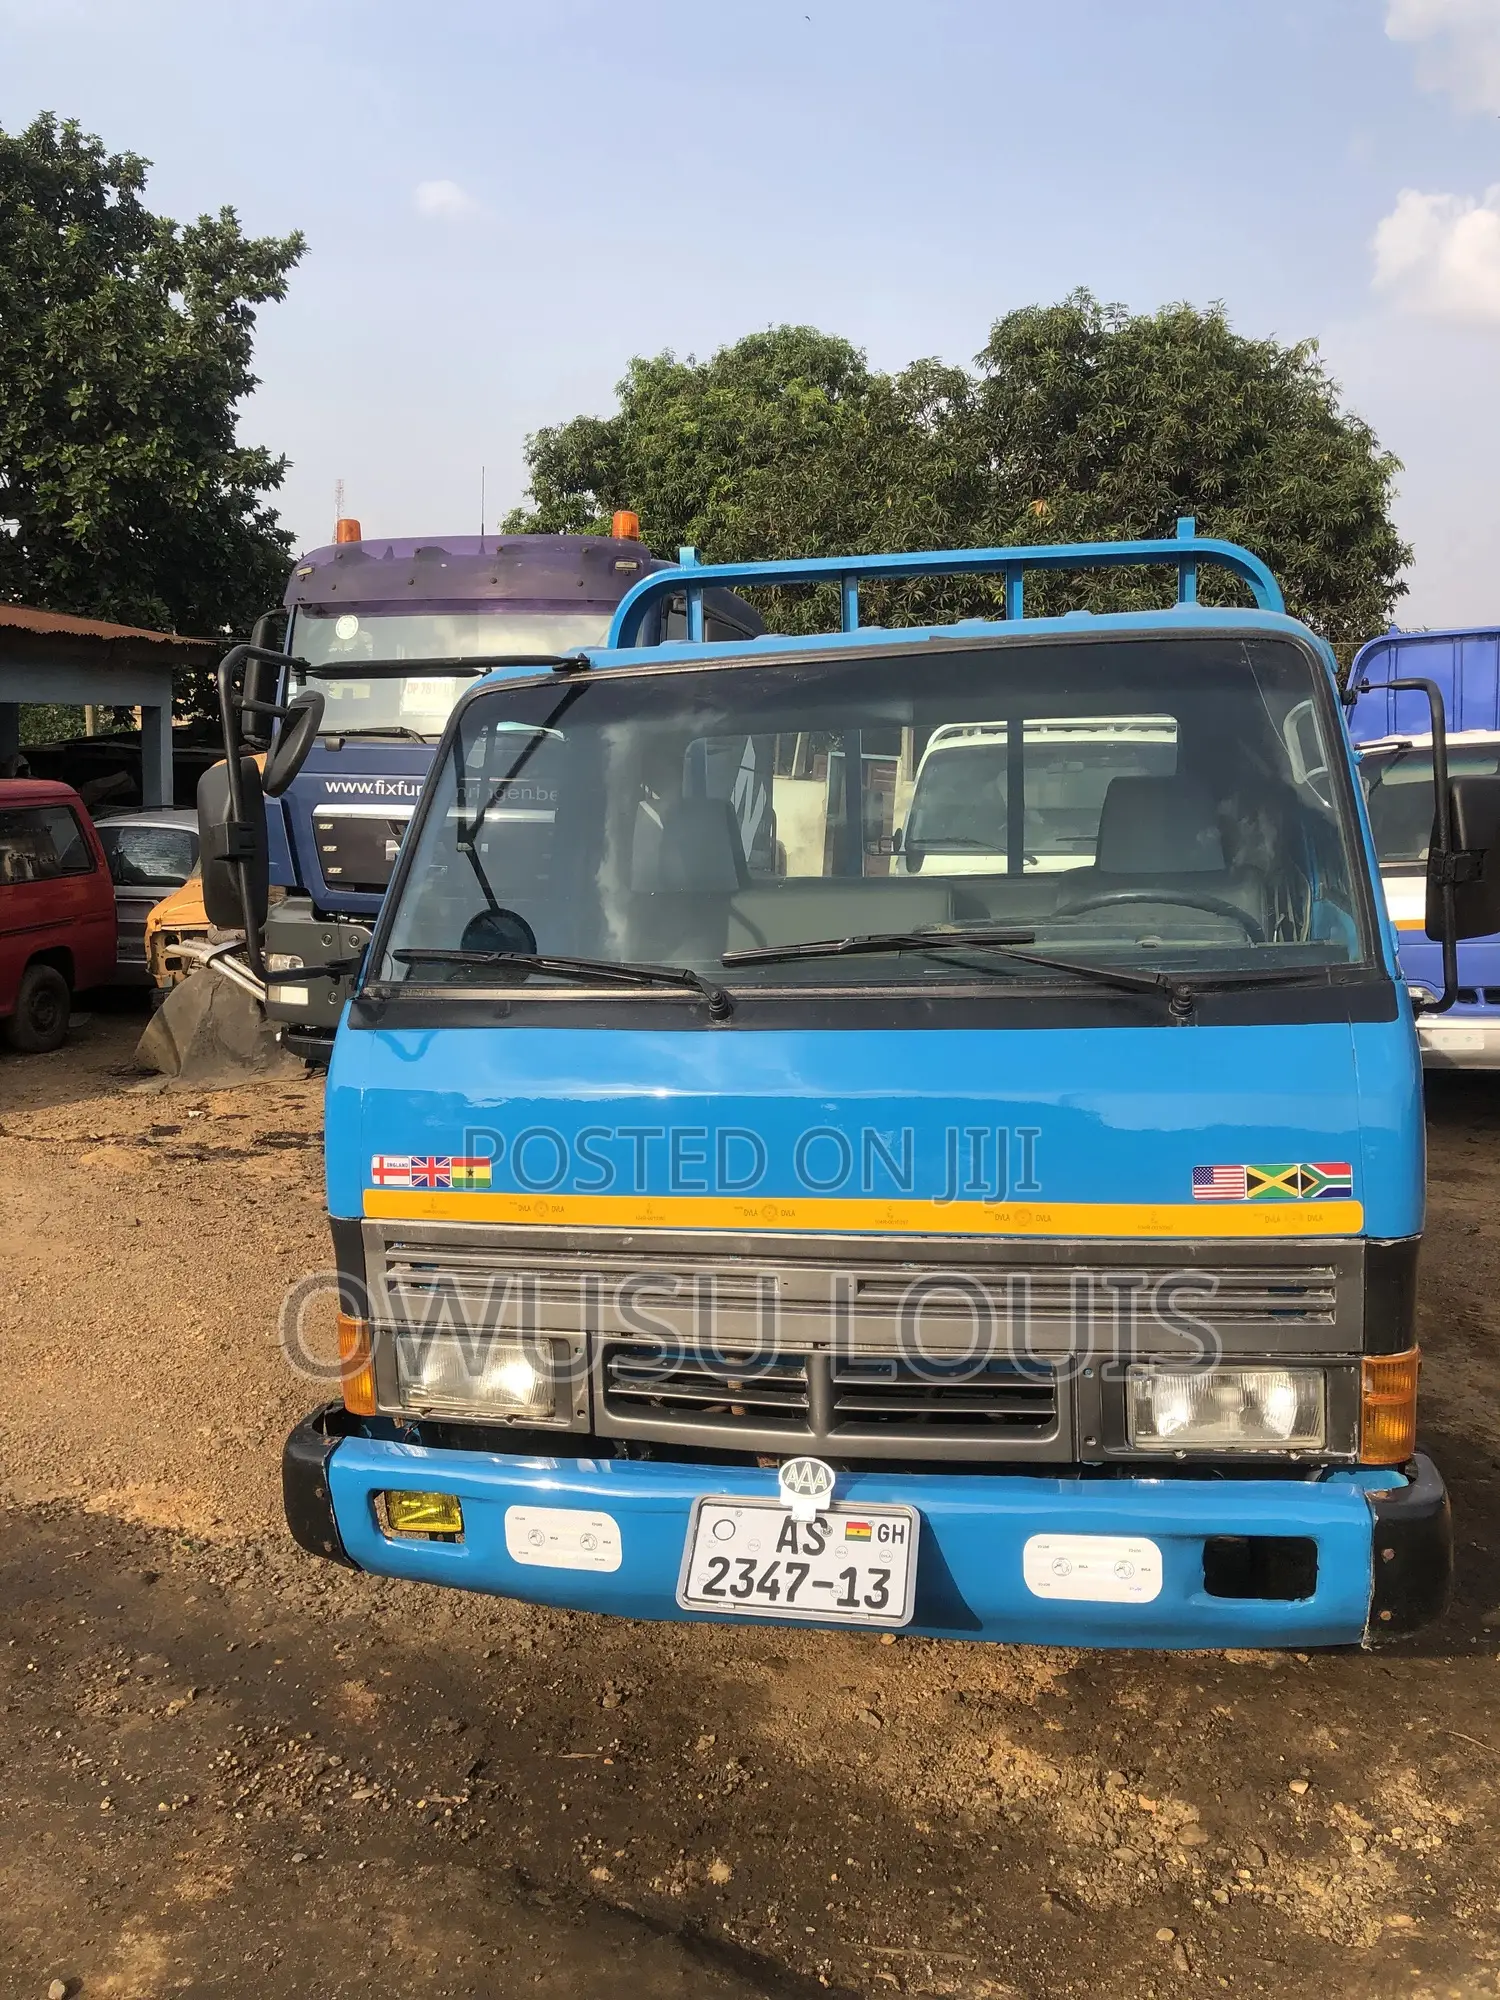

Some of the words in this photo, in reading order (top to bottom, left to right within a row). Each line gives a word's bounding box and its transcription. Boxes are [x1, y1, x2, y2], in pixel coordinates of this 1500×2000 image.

[994, 1213, 1010, 1221] DVLA
[1035, 1214, 1052, 1222] DVLA
[784, 1461, 828, 1495] AAA
[775, 1516, 829, 1556] AS
[877, 1523, 905, 1544] GH
[702, 1556, 892, 1610] 2347-13
